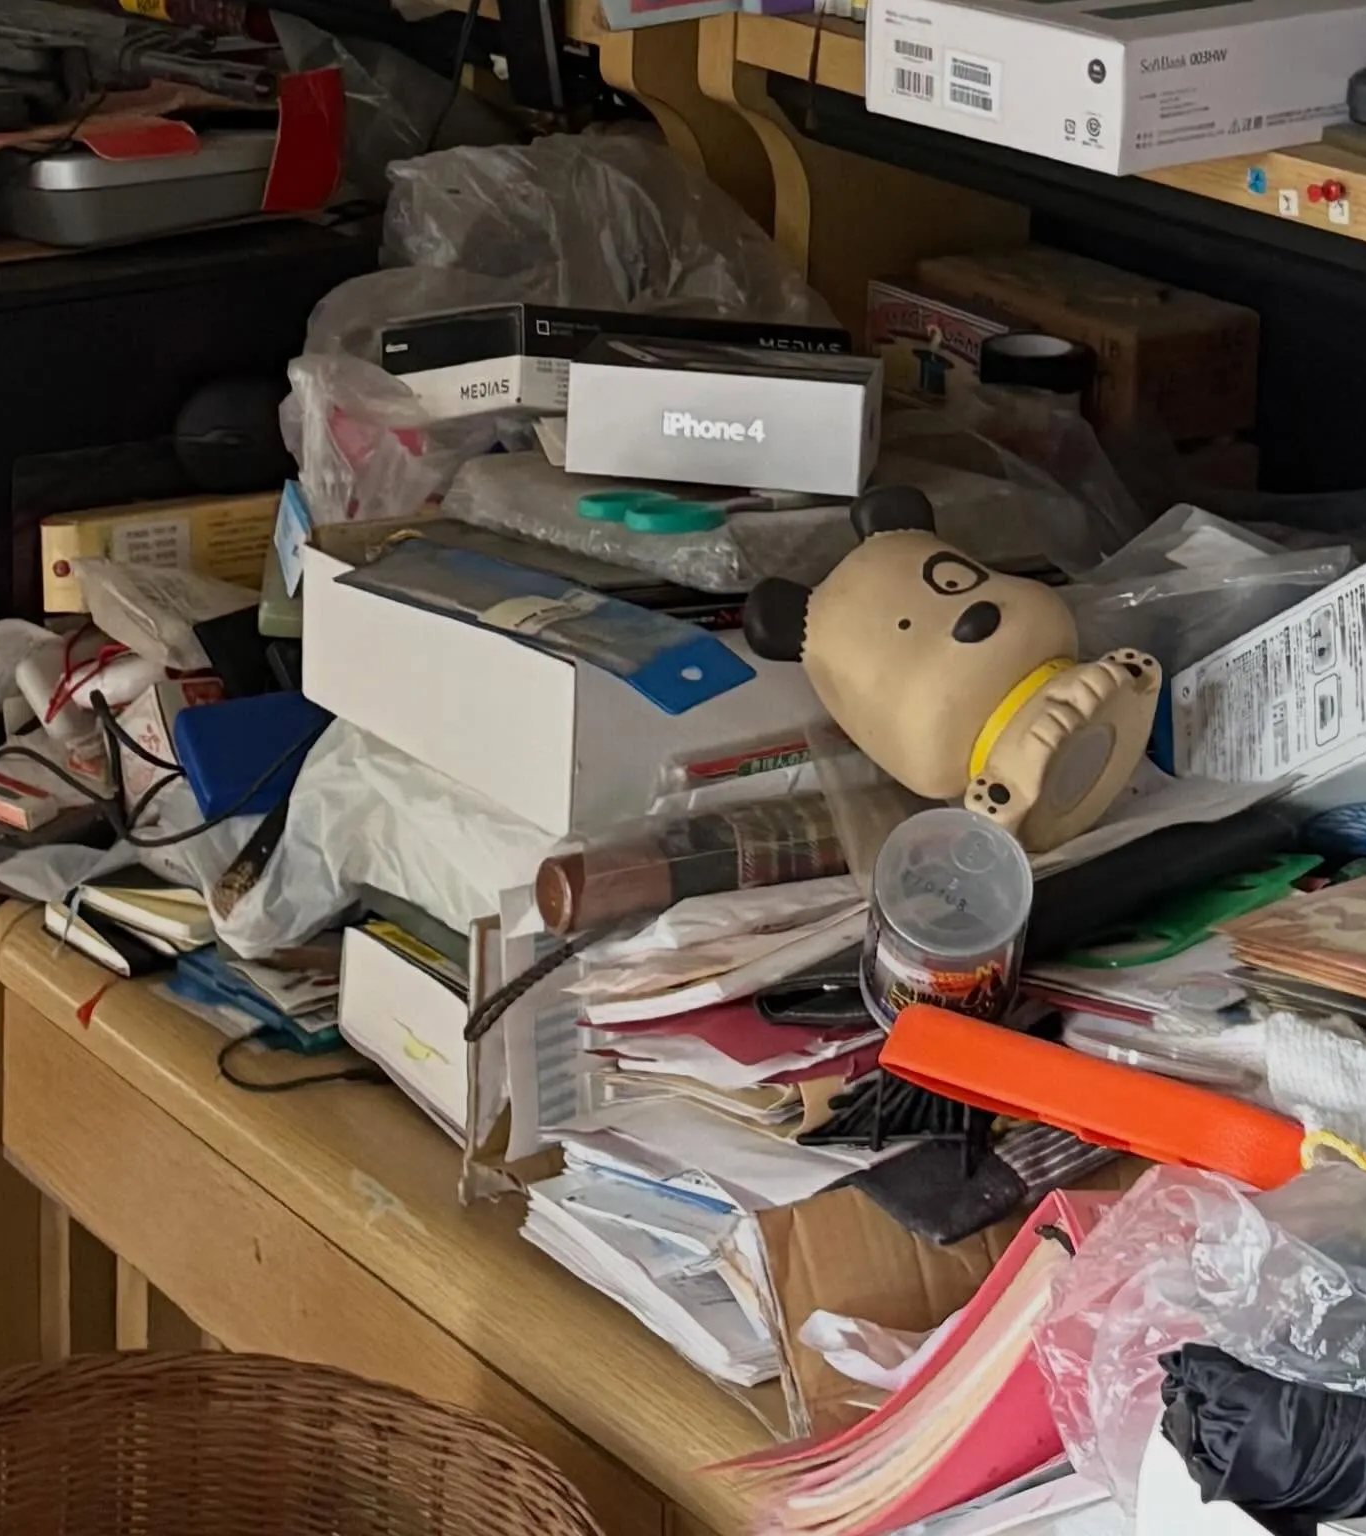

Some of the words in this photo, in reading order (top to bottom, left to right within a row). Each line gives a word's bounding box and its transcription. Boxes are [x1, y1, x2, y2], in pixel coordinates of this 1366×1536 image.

[1139, 53, 1187, 74] SoftBank
[1189, 48, 1228, 66] 003HW
[459, 378, 511, 402] MEDIAS
[662, 409, 745, 443] iPhone
[745, 418, 767, 444] 4
